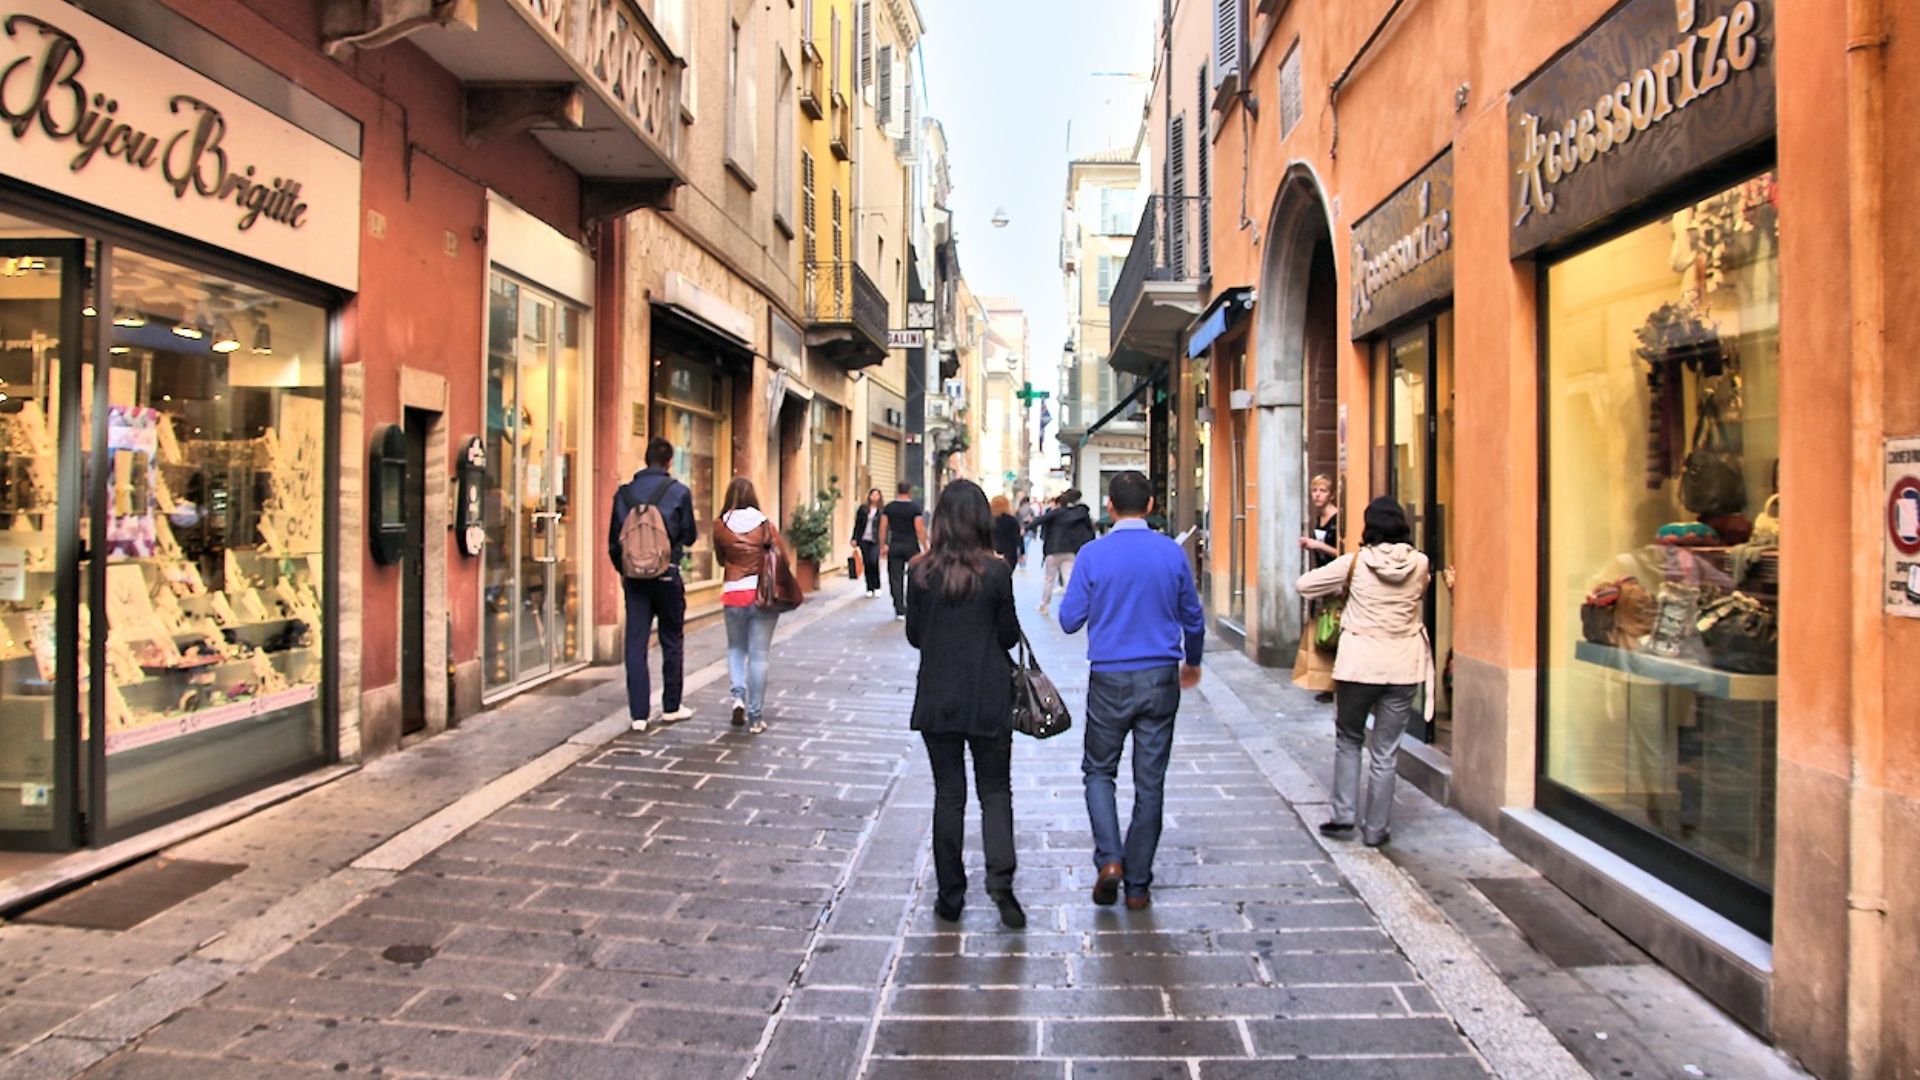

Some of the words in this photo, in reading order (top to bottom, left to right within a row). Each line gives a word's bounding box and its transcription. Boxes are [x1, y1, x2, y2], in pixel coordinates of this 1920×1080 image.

[0, 14, 159, 173] Bijou
[162, 94, 308, 231] Brigitte
[1514, 0, 1757, 227] Accessorize
[1352, 181, 1449, 320] Accessorize
